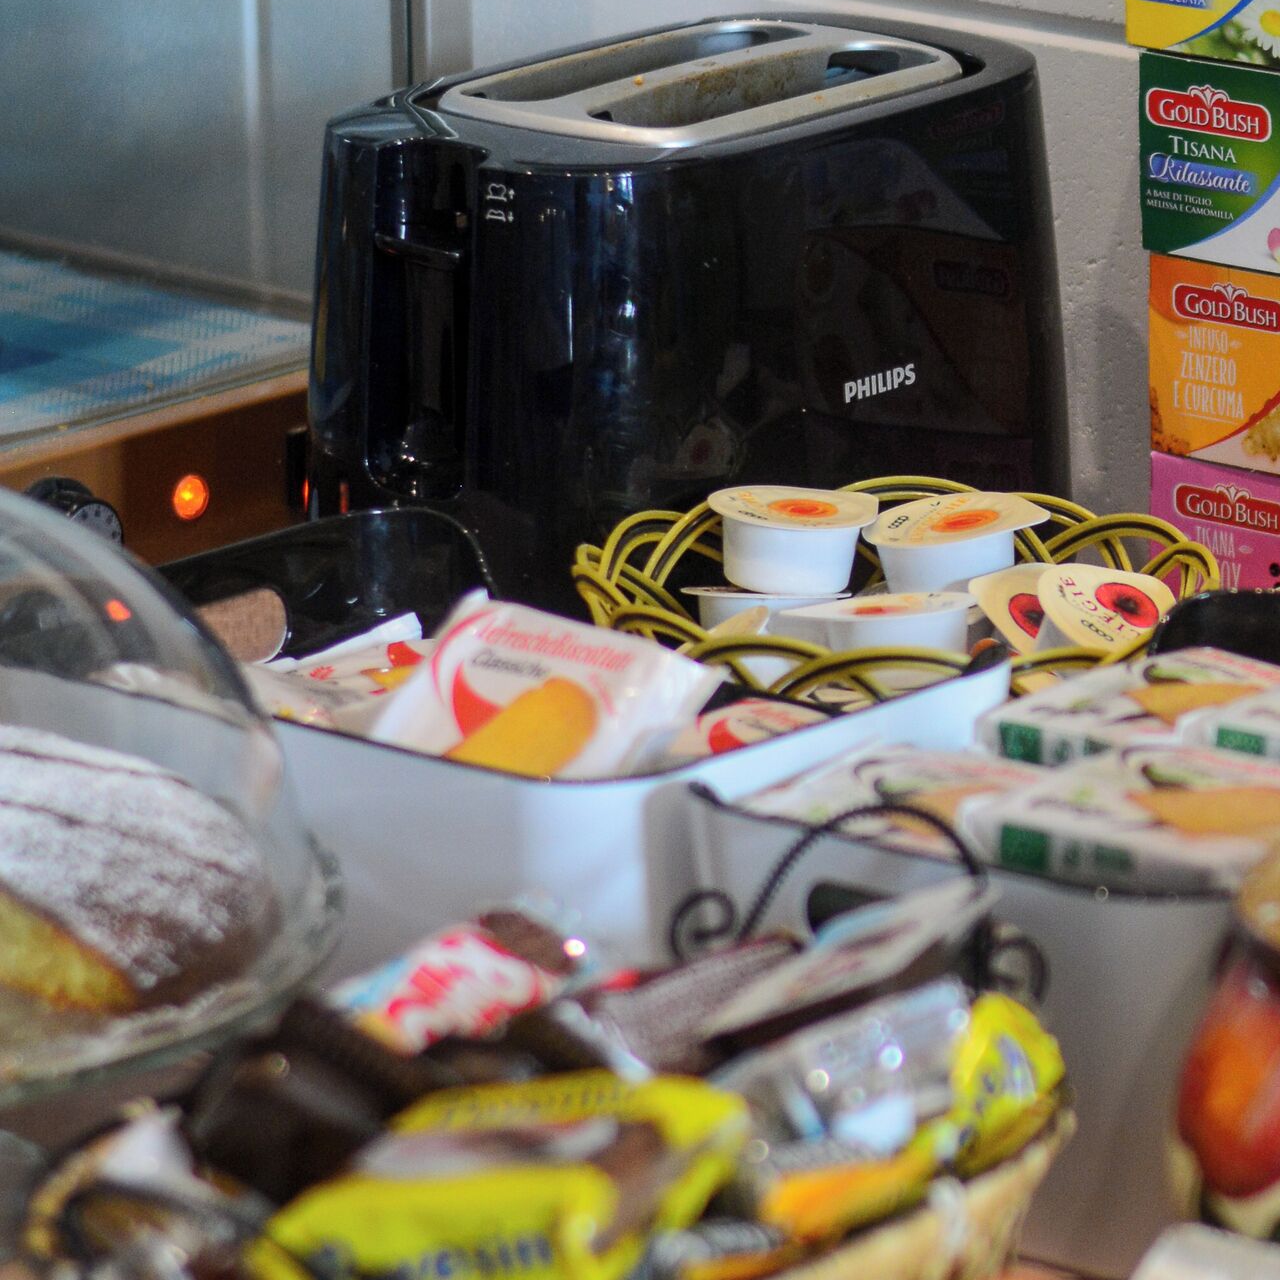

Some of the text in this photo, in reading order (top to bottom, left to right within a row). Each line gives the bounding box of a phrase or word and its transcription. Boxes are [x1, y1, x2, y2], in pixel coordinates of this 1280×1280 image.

[1160, 99, 1259, 135] GOLD BUSH
[1168, 135, 1237, 164] TISANA
[1149, 152, 1251, 193] Rilassante
[1146, 188, 1152, 196] A
[1153, 190, 1170, 199] BASE
[1172, 192, 1182, 201] DI
[1147, 199, 1234, 220] MELISSA E CAMOMILLA
[1185, 293, 1277, 327] GOLD BUSH
[1189, 325, 1228, 354] INFUSO
[844, 363, 916, 404] PHILIPS
[1181, 351, 1237, 387] ZENZERO
[1174, 380, 1244, 420] E CURCUMA
[1186, 494, 1278, 529] GOLD BUSH
